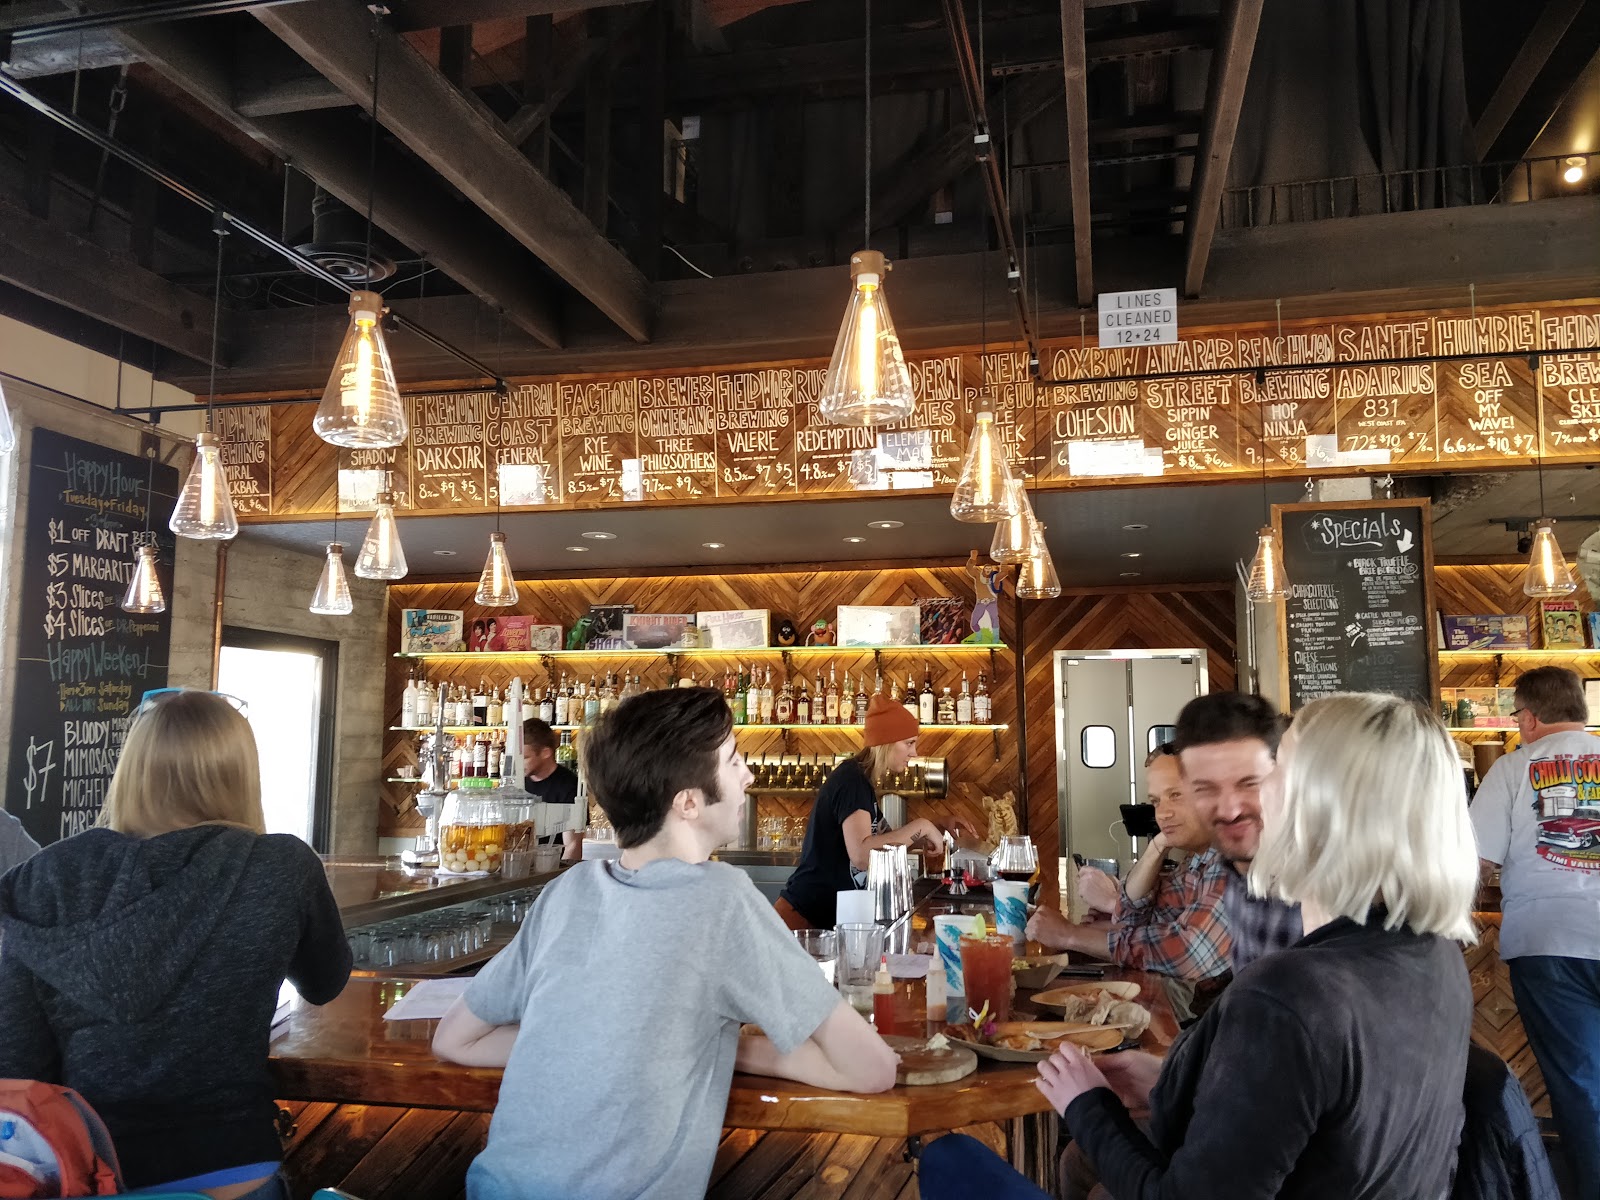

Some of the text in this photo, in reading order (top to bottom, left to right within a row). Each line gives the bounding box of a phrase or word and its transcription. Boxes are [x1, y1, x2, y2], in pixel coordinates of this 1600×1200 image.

[1117, 293, 1162, 309] LINES
[1106, 309, 1172, 327] CLEANED
[1338, 322, 1430, 363] SANTE
[1437, 314, 1534, 356] HUMBLE
[980, 351, 1030, 385] NEW
[1053, 346, 1141, 382] OXBOW
[1459, 361, 1513, 389] SEA
[639, 375, 714, 409] BREWERY
[716, 369, 793, 412] FIELDWORK
[1053, 380, 1138, 405] BREWING
[1240, 374, 1331, 404] BREWING
[1337, 365, 1434, 399] ADAIRIUS
[485, 383, 557, 421] CENTRAL
[561, 380, 635, 417] FACTION
[1147, 379, 1232, 409] STREET
[1475, 389, 1503, 404] OFF
[412, 393, 484, 427] FREMONT
[716, 409, 789, 431] BREWING
[1167, 406, 1213, 422] SIPPIN'
[1272, 402, 1299, 420] HOP
[1363, 399, 1398, 418] 831
[1479, 403, 1500, 418] MY
[486, 417, 552, 447] COAST
[562, 414, 635, 438] BREWING
[639, 405, 714, 438] OMMEGANG
[1056, 405, 1135, 438] COHESION
[1165, 425, 1219, 441] GINGER
[1264, 420, 1308, 437] NINJA
[1468, 416, 1515, 431] WAVE!
[413, 424, 484, 446] BREWING
[584, 436, 610, 454] RYE
[656, 438, 694, 453] THREE
[727, 430, 779, 453] VALERIE
[797, 426, 874, 453] REDEMPTION
[886, 428, 957, 447] ELEMENTAL
[1173, 440, 1206, 452] JUICE
[351, 449, 396, 466] SHADOW
[417, 446, 484, 471] DARKSTAR
[495, 447, 548, 465] GENERAL
[579, 454, 614, 472] WINE
[641, 452, 715, 471] PHILOSOPHERS
[223, 465, 254, 480] MIRAL
[228, 480, 259, 494] CKBAR
[48, 518, 159, 553] $1 OFF DRAFT BEER
[47, 552, 69, 577] $5
[46, 582, 68, 609] $3
[70, 584, 105, 610] Slices
[1303, 598, 1339, 610] SELECTIONS
[44, 609, 66, 640] $4
[68, 609, 105, 637] Slices
[630, 616, 662, 626] KNIGHT
[1294, 651, 1318, 665] CHEESE
[1305, 662, 1338, 673] SELECTIONS
[97, 699, 130, 716] Sunday
[64, 720, 110, 749] BLOODY
[23, 736, 57, 810] $7
[64, 748, 115, 777] MIMOSAS
[1529, 760, 1572, 791] CHILLI
[1546, 852, 1568, 865] SIMI
